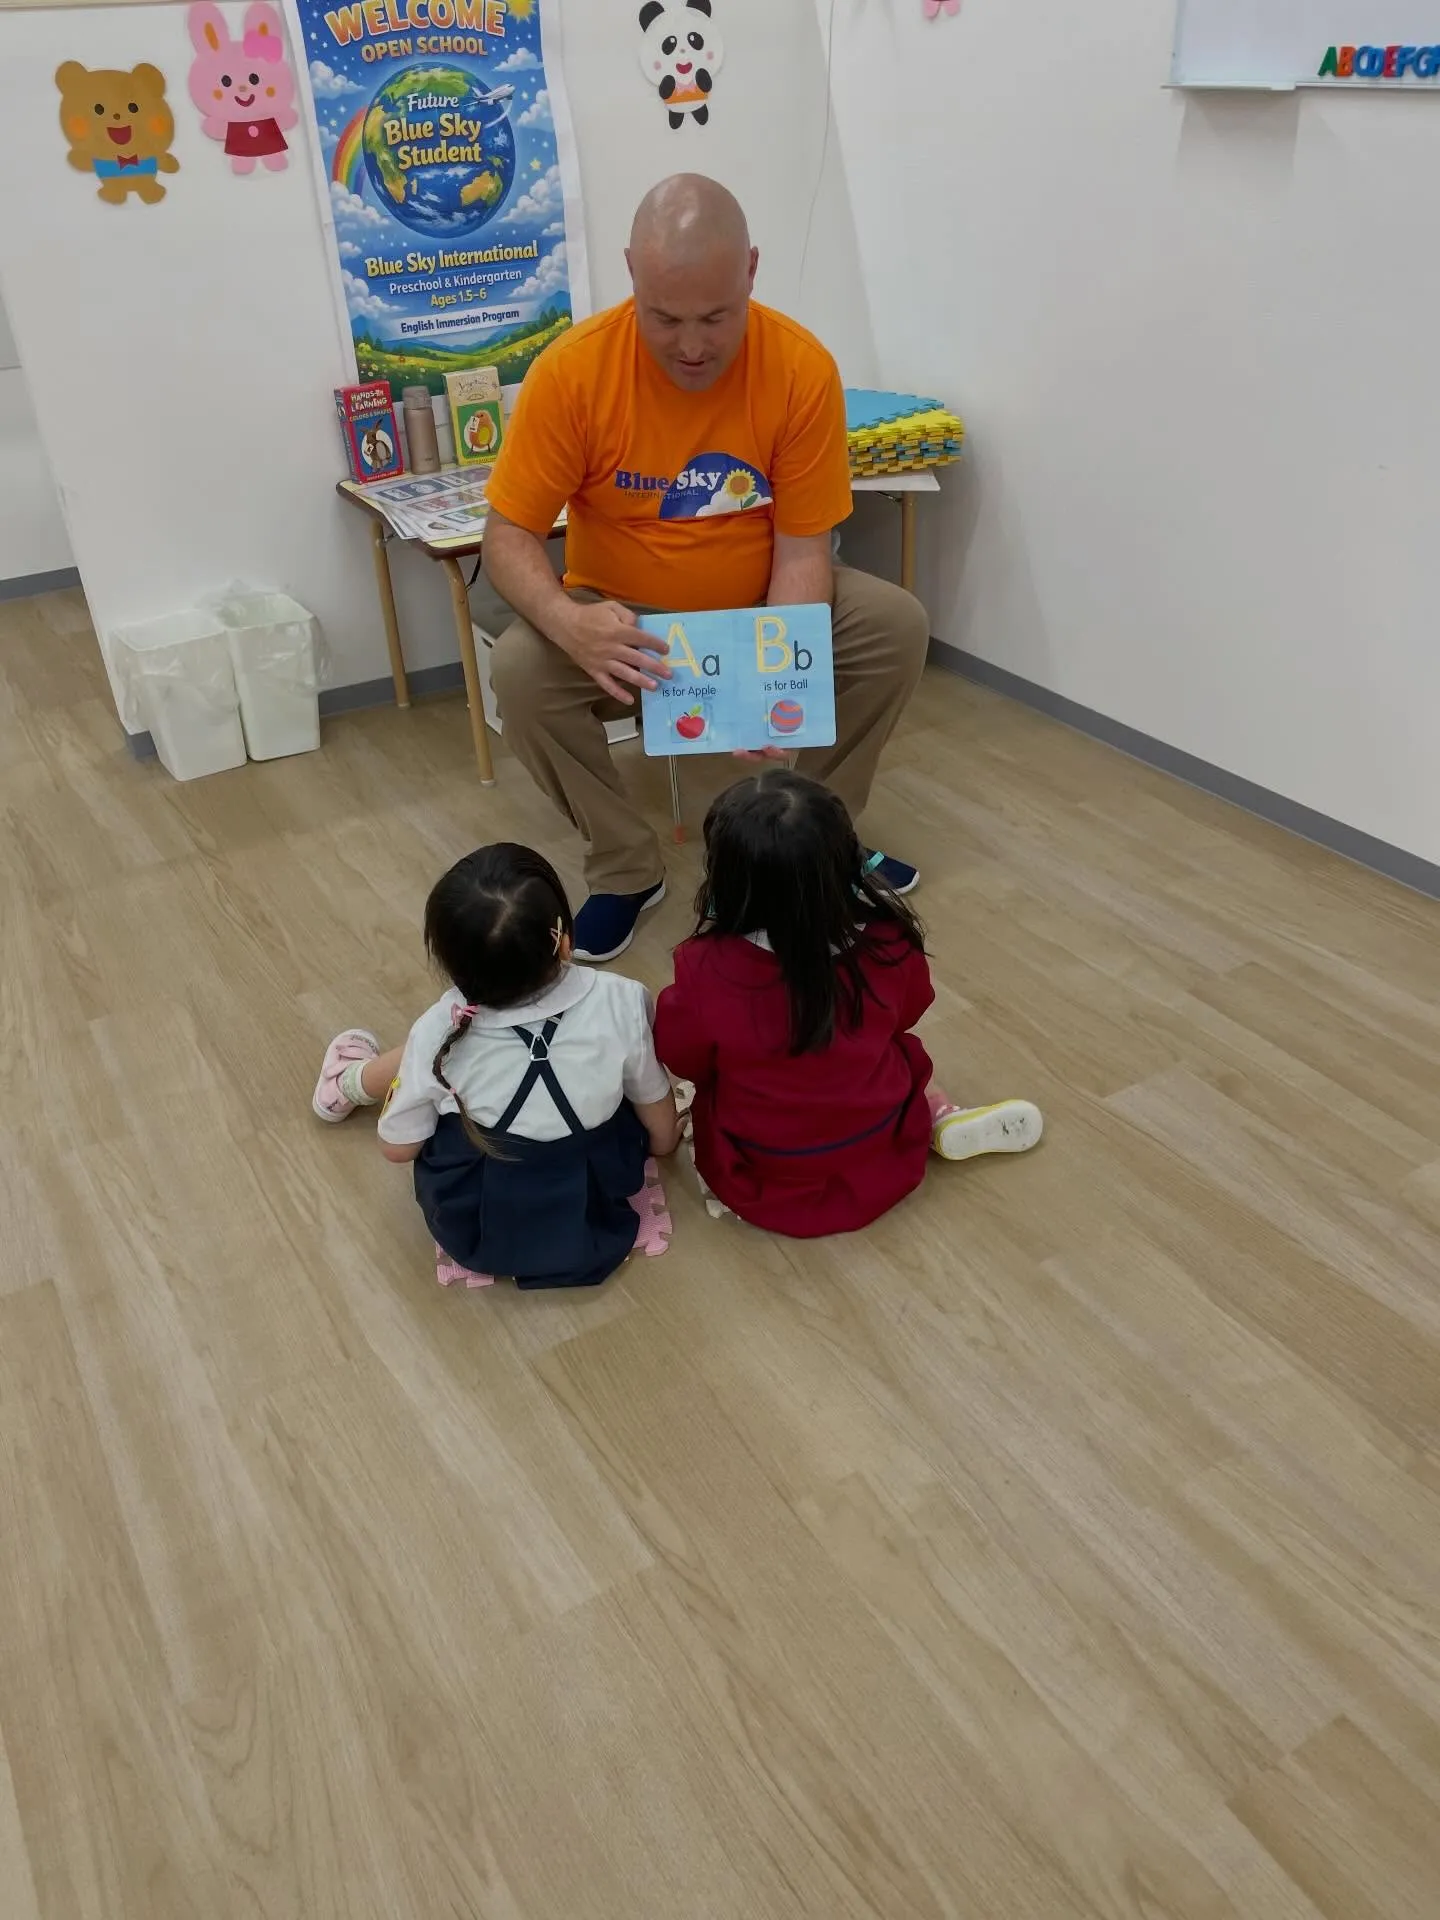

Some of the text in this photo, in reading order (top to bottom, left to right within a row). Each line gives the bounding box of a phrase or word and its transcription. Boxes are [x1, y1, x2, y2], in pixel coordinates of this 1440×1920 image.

[324, 0, 506, 46] WELCOME
[361, 36, 488, 63] OPEN SCHOOL
[407, 92, 459, 112] Future
[384, 113, 482, 145] Blue Sky
[397, 139, 482, 170] Student
[365, 240, 538, 278] Blue Sky International
[390, 277, 442, 295] Preschool
[454, 269, 522, 287] Kindergarten
[431, 293, 457, 309] Ages
[401, 309, 520, 335] English Immersion Program
[351, 397, 387, 413] LEARNING
[615, 468, 721, 491] Blue Sky
[662, 685, 716, 699] is for Apple
[764, 679, 808, 692] is for Ball
